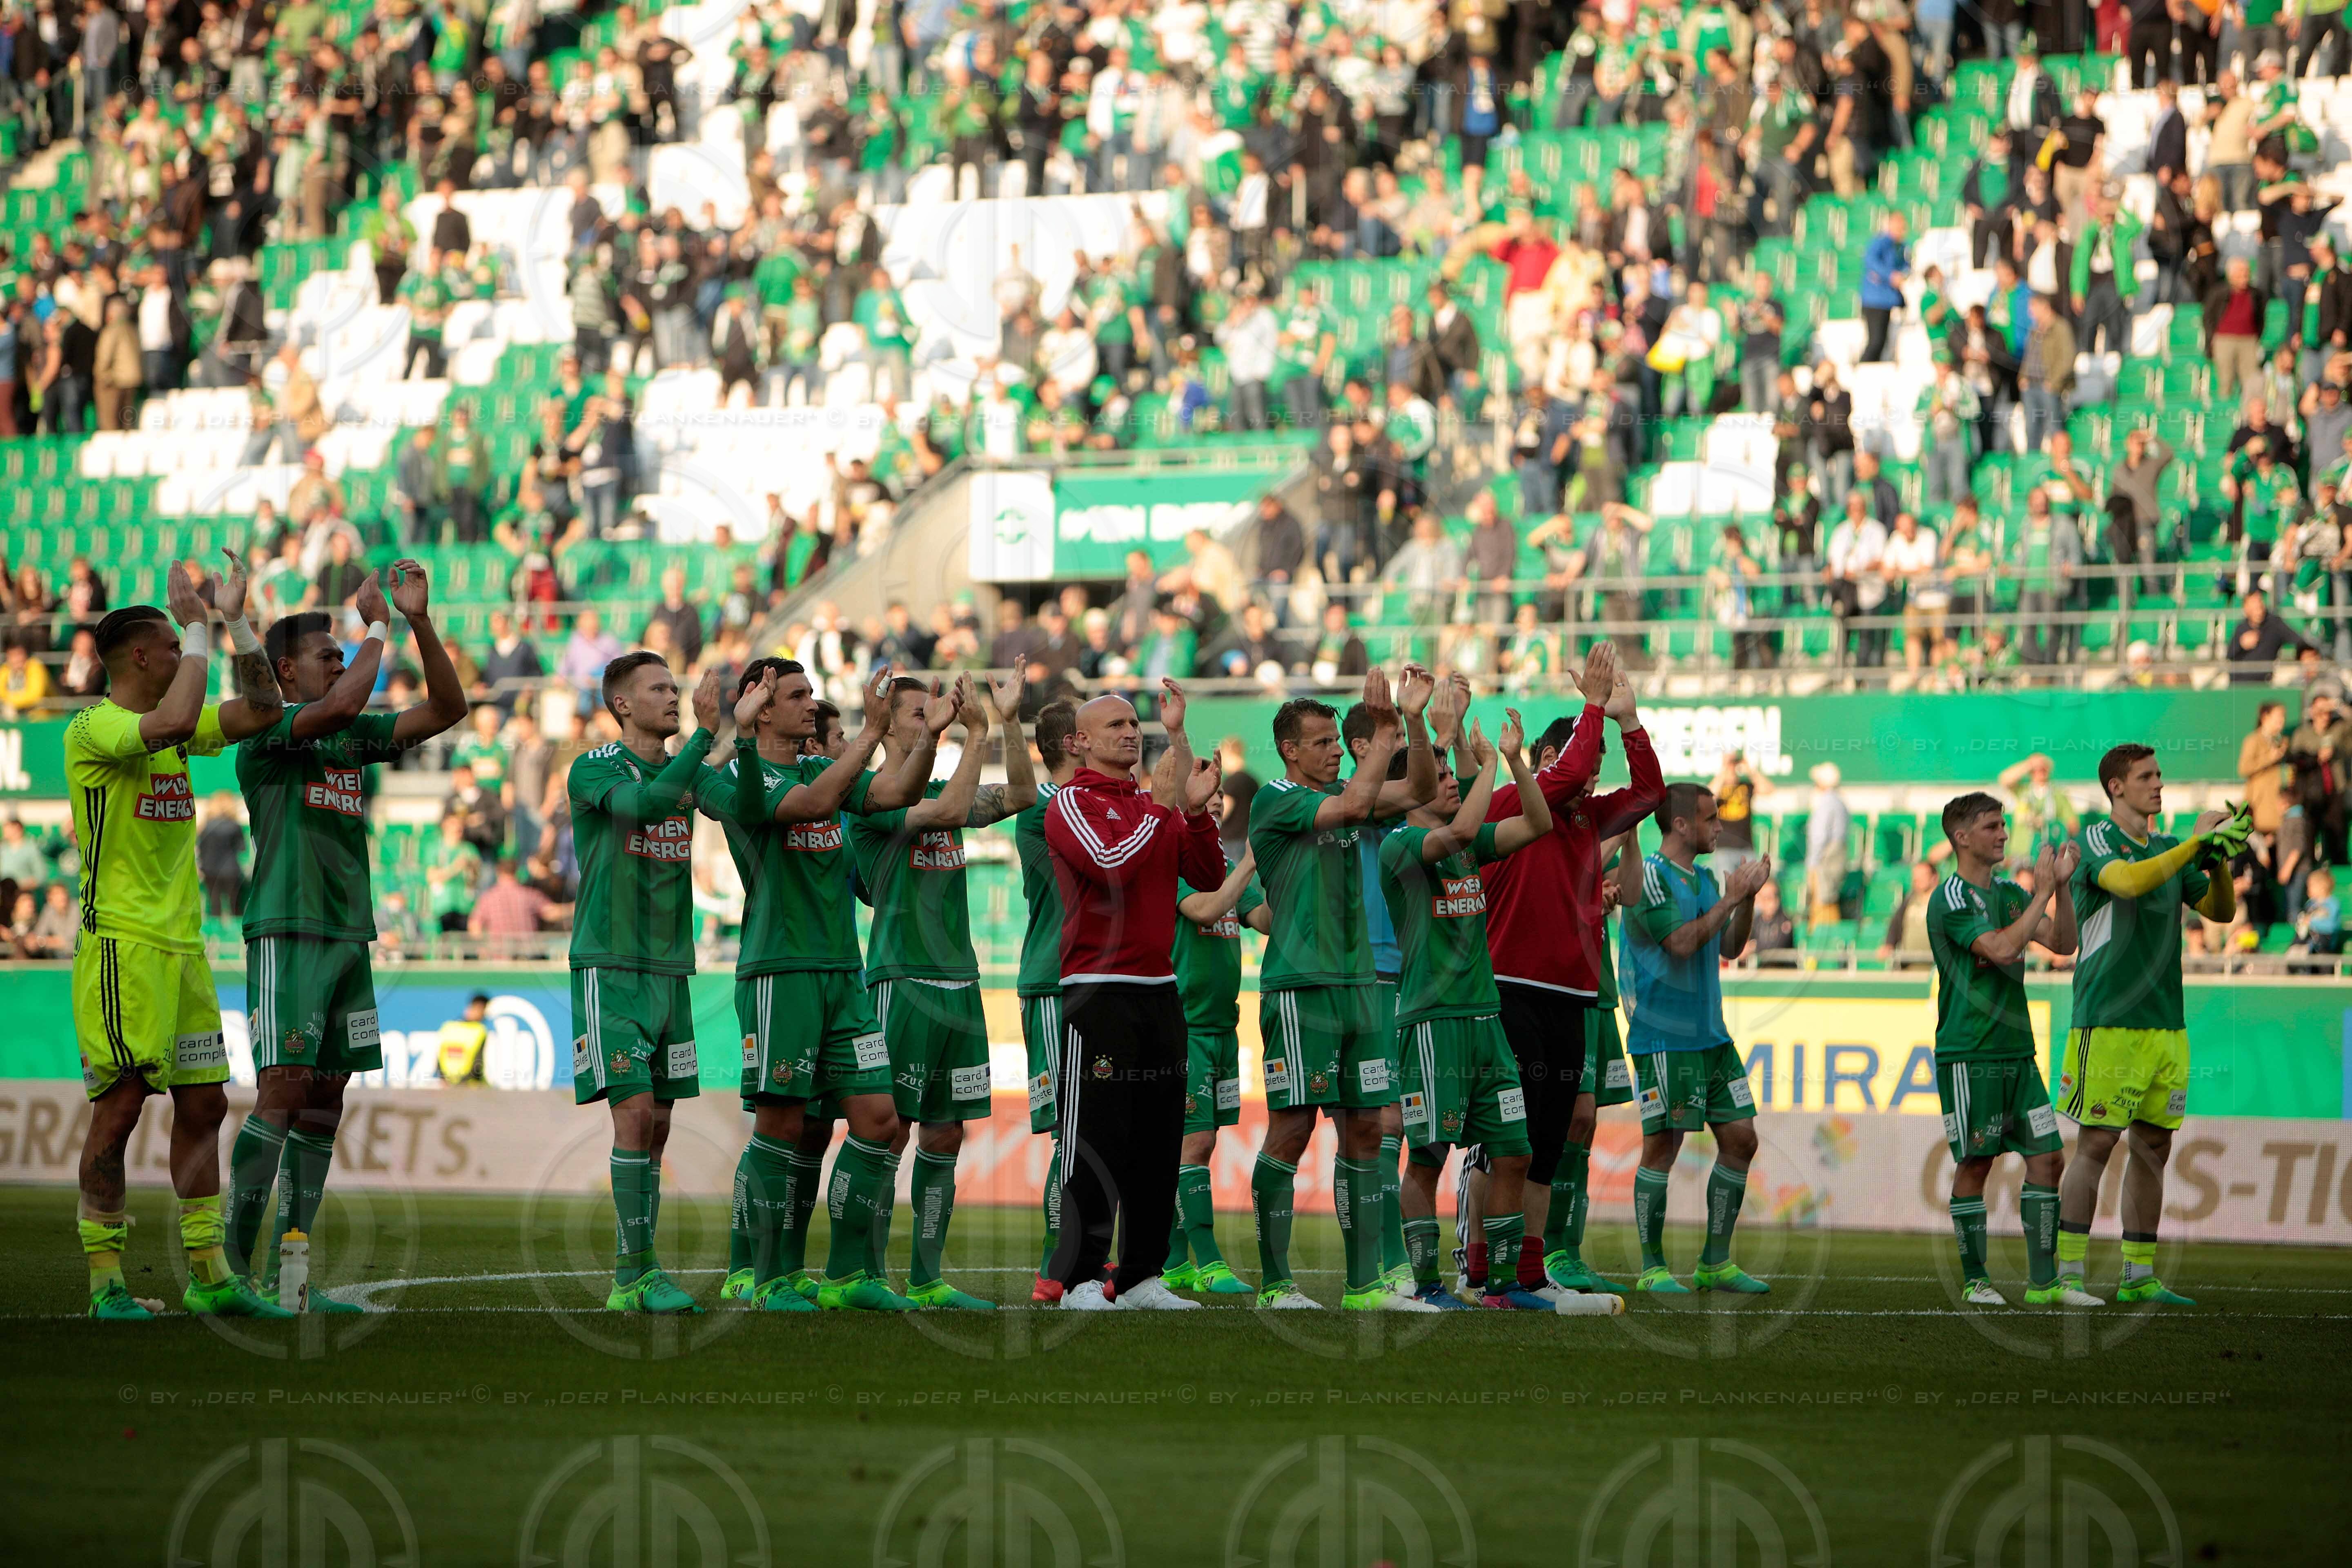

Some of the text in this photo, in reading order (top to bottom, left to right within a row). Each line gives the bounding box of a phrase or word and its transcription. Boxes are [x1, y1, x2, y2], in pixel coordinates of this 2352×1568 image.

[139, 797, 195, 818] ENERGI
[923, 831, 951, 848] WEN
[629, 834, 692, 859] ENERG
[913, 848, 967, 867] ENRGIE
[351, 1016, 375, 1027] card
[352, 1029, 380, 1040] comp
[179, 1036, 212, 1049] card
[858, 1038, 883, 1050] card
[179, 1048, 225, 1062] comple
[672, 1046, 691, 1059] card
[861, 1051, 888, 1062] comp
[575, 1054, 588, 1070] plete
[672, 1060, 697, 1071] comp
[1363, 1062, 1383, 1074] card
[955, 1071, 981, 1082] card
[1364, 1076, 1389, 1085] comp
[1743, 1044, 1939, 1105] MIRA
[956, 1080, 991, 1094] compl
[1266, 1075, 1286, 1088] plete
[2171, 1094, 2186, 1102] car
[1405, 1108, 1423, 1120] plete
[227, 1099, 489, 1177] TKETS.
[303, 1190, 324, 1199] SC
[922, 1186, 942, 1238] RAPIDSHOP.AT
[627, 1216, 649, 1227] SCR
